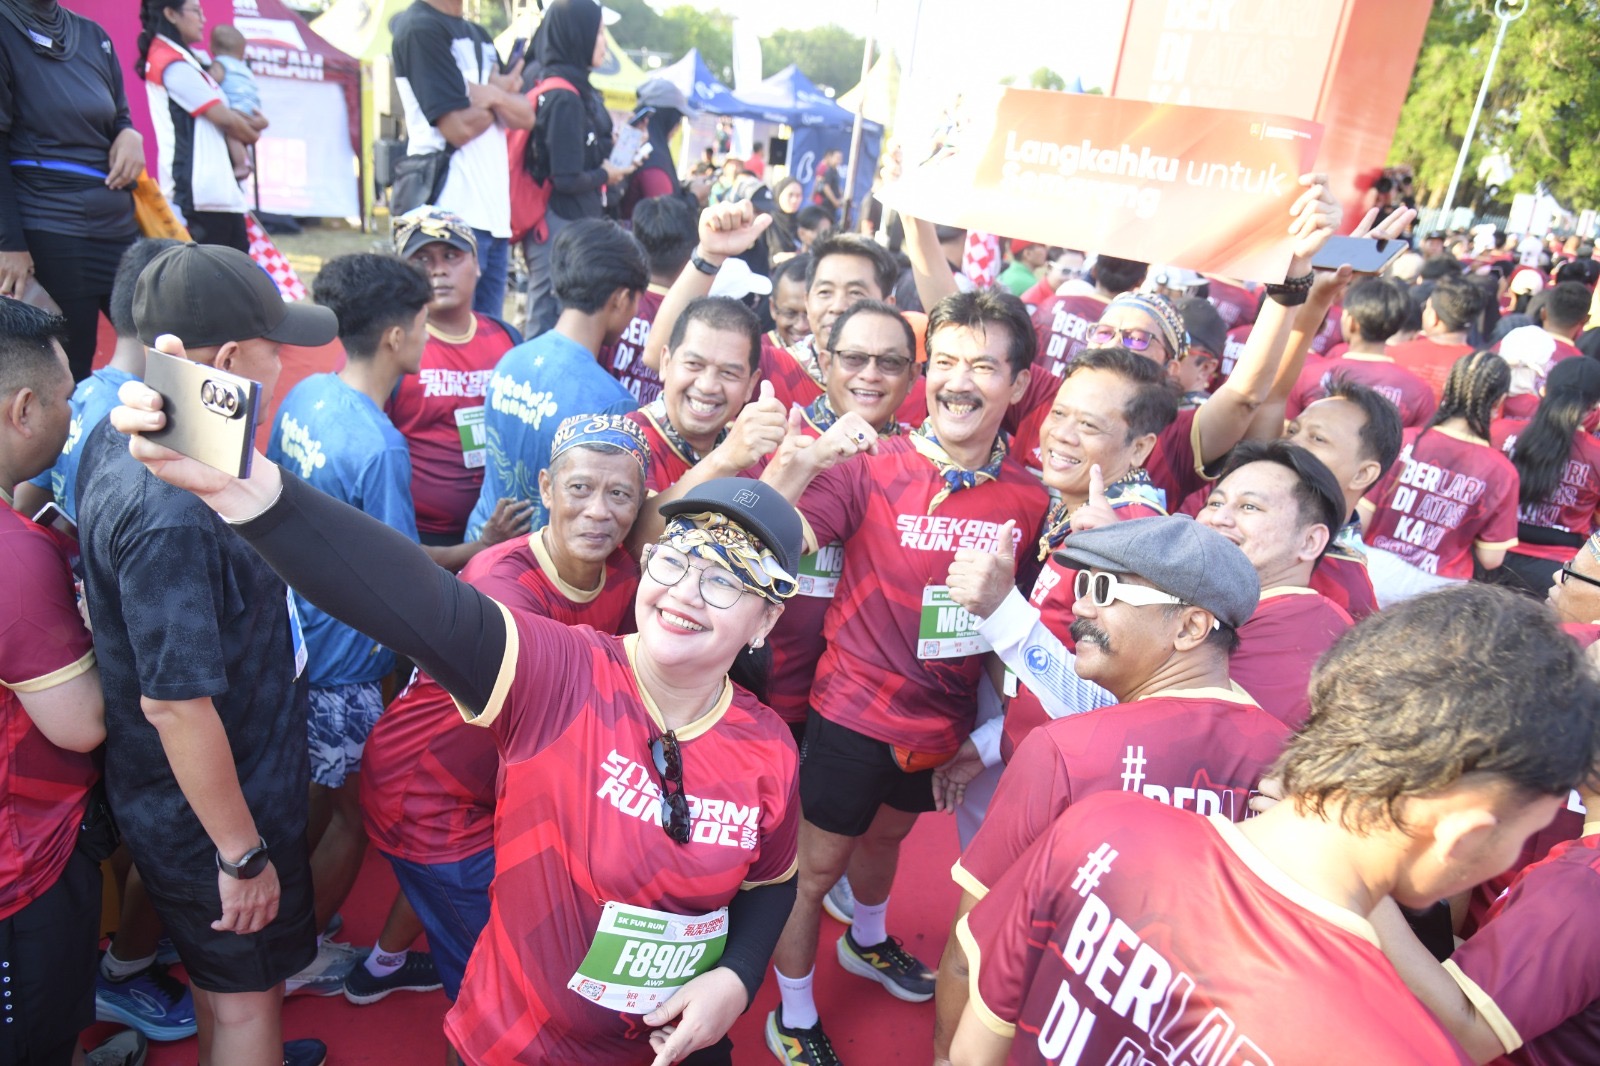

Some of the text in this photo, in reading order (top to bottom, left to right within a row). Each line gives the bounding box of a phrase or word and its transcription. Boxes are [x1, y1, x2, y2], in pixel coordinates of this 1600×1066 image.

[1005, 130, 1288, 197] Langkahku untuk
[1046, 333, 1068, 360] DI
[1400, 458, 1488, 506] BERLARI
[1391, 485, 1469, 530] DI ATAS
[617, 916, 665, 931] 5K FUN RUN
[612, 939, 707, 979] F8902
[1062, 892, 1275, 1066] BERLA
[626, 992, 639, 1000] BER
[643, 979, 665, 987] AWP
[1038, 978, 1096, 1066] DI
